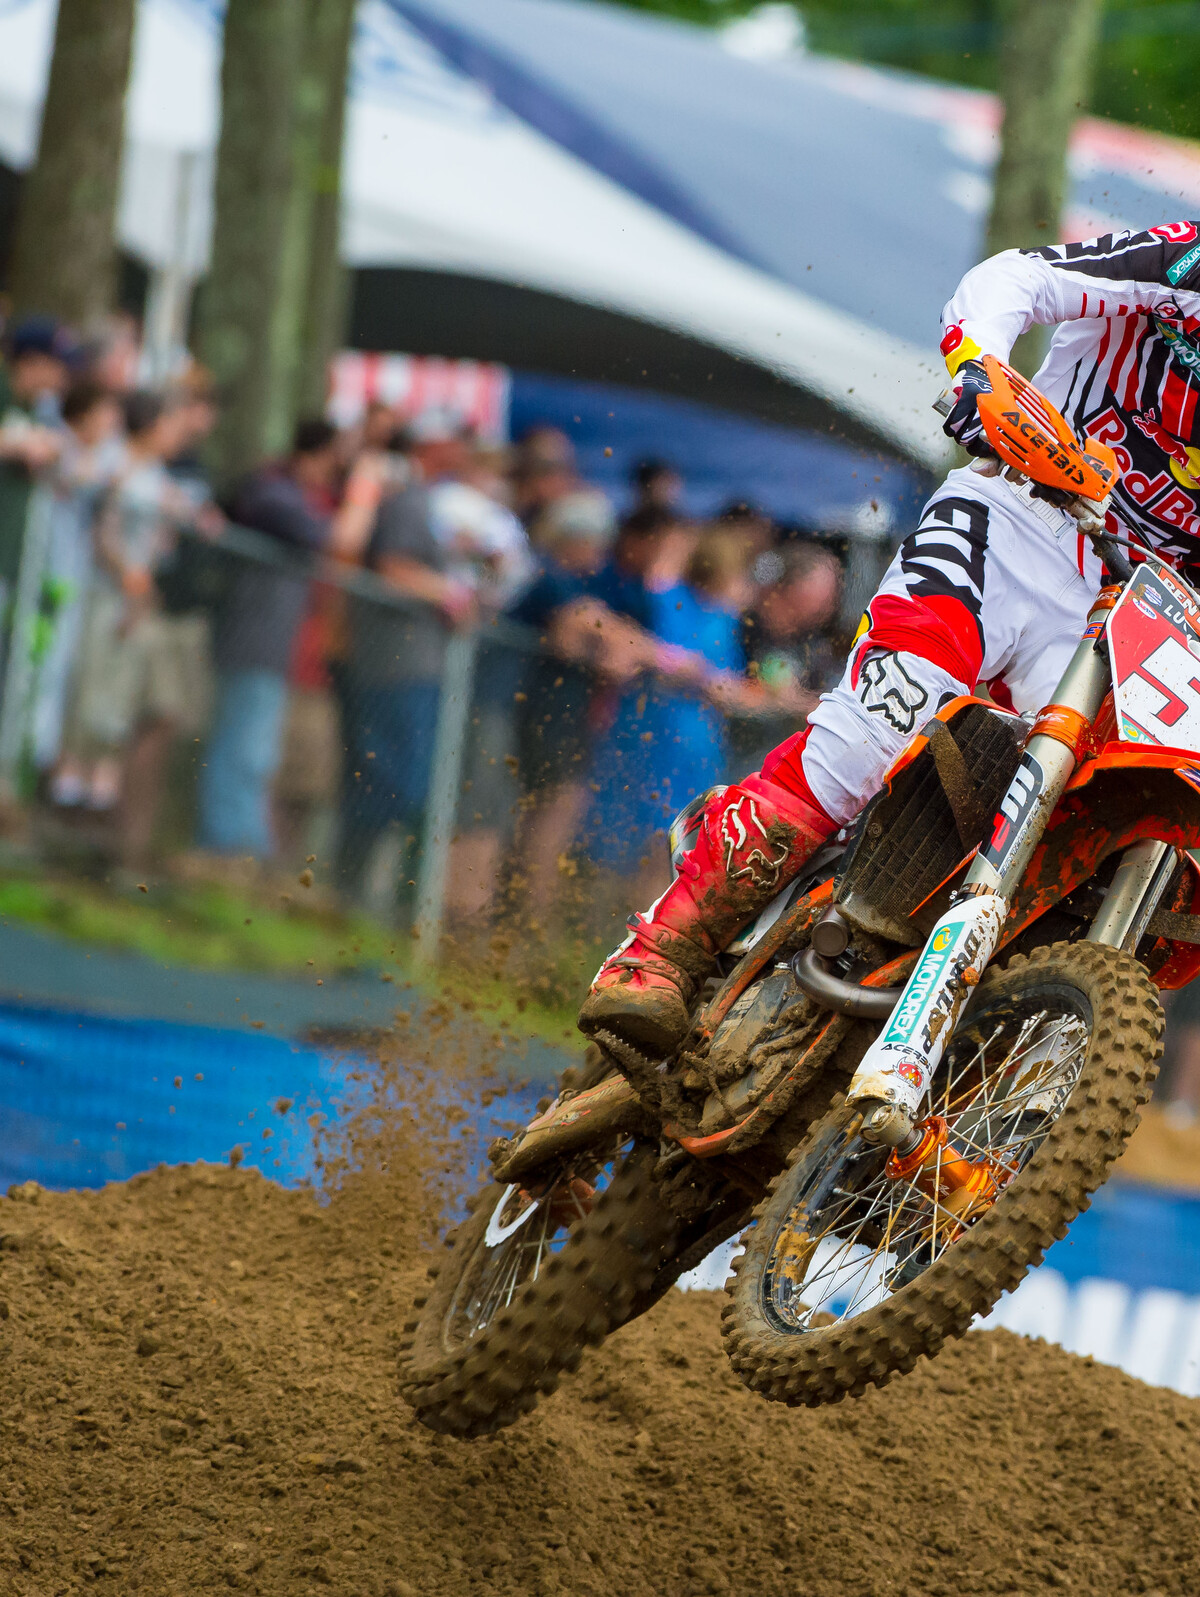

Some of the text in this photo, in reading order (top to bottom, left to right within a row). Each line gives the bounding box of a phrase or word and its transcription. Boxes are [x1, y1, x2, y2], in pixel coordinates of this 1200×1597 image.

[1002, 411, 1084, 485] ACERBIS
[1083, 405, 1173, 508] Red
[990, 763, 1035, 853] WP
[888, 953, 946, 1042] MOTOREX
